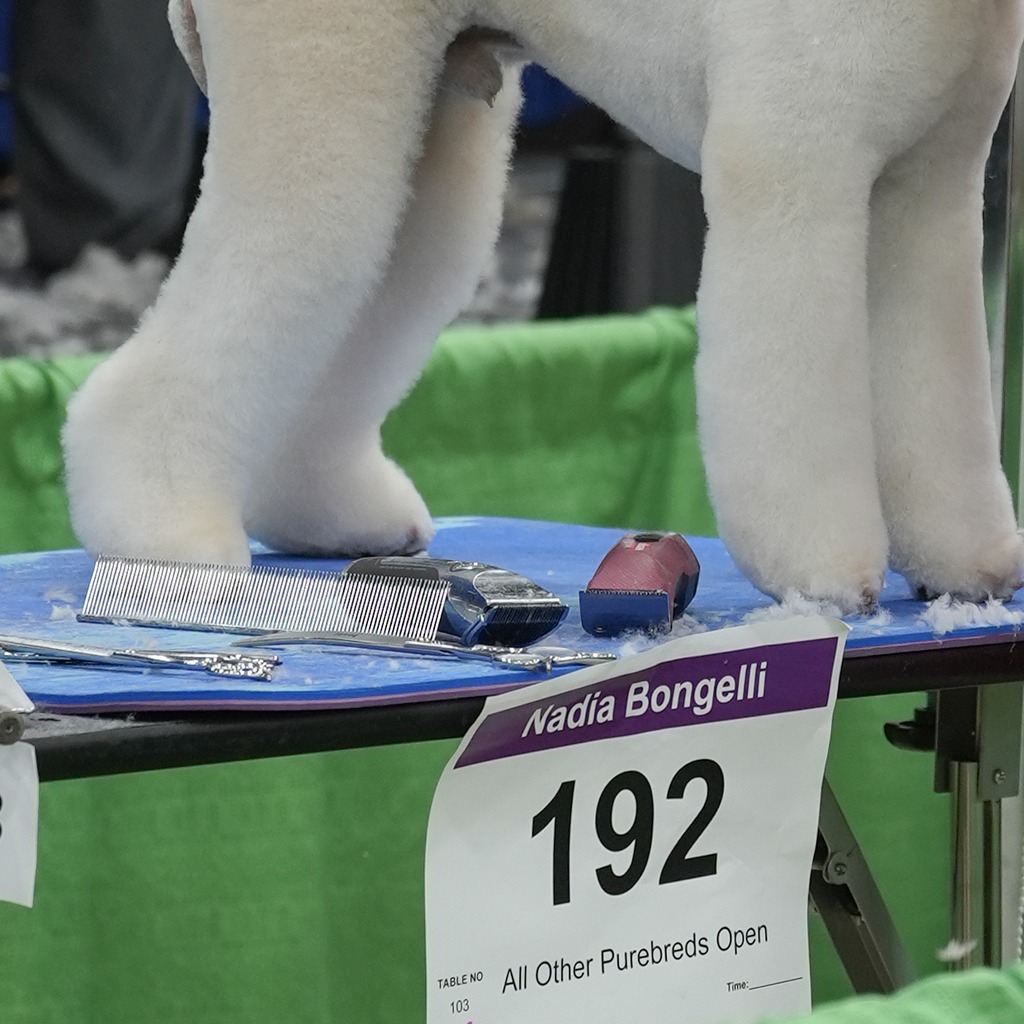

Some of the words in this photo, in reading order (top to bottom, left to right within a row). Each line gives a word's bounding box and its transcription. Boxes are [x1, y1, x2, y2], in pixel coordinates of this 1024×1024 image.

[521, 690, 616, 739] Nadia
[624, 661, 768, 717] Bongelli
[530, 758, 725, 907] 192
[437, 974, 468, 990] TABLE
[469, 970, 484, 984] NO
[502, 964, 528, 995] All
[534, 957, 594, 987] Other
[600, 932, 710, 975] Purebreds
[715, 923, 769, 956] Open
[449, 997, 471, 1015] 103
[726, 980, 750, 993] Time:
